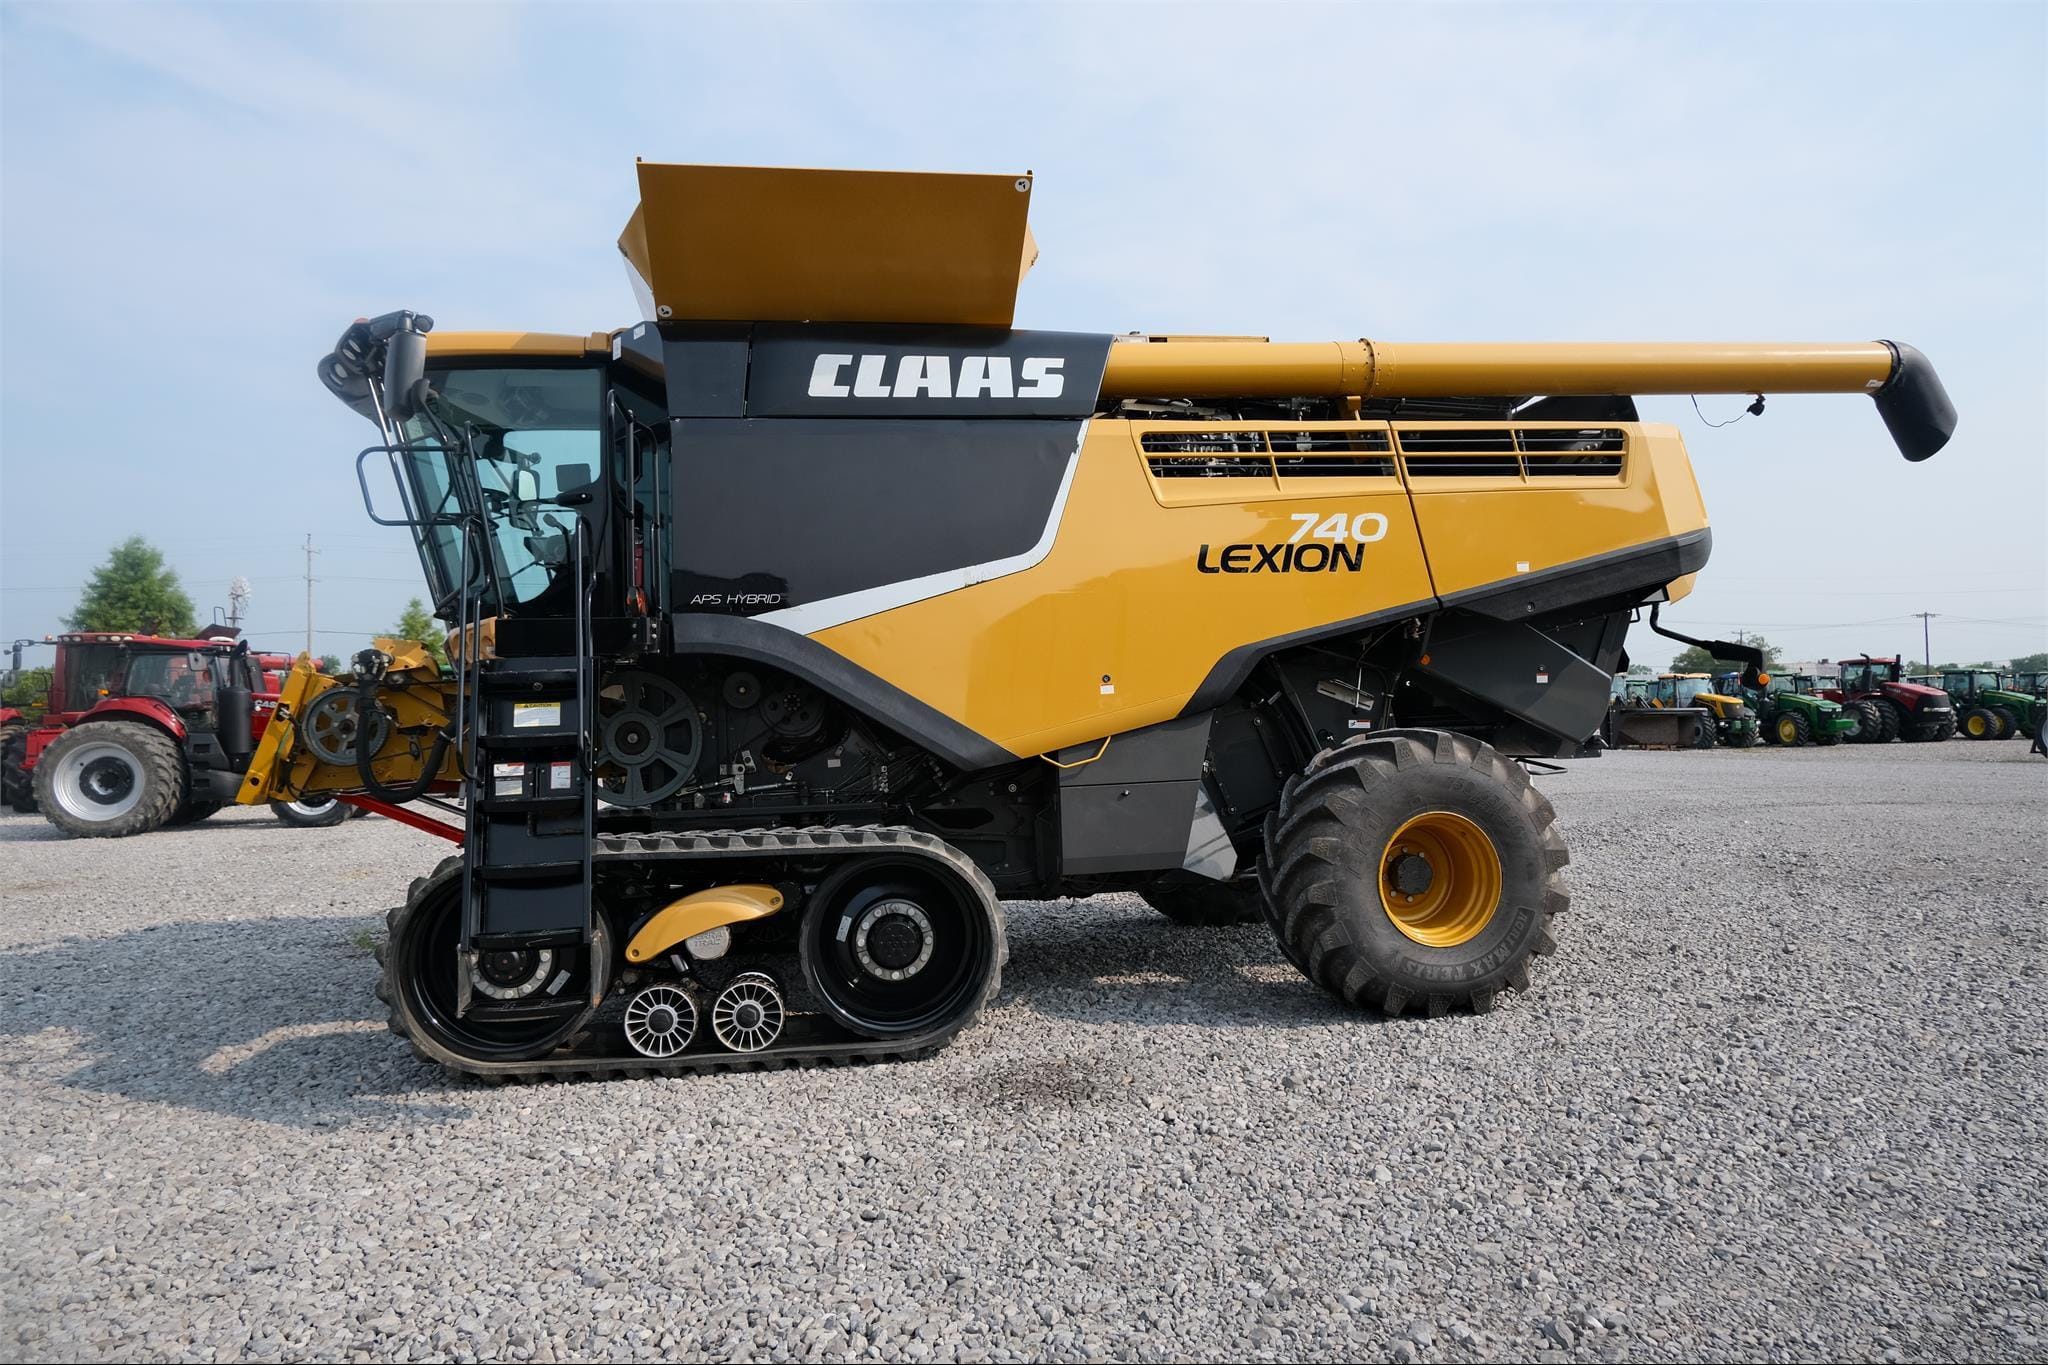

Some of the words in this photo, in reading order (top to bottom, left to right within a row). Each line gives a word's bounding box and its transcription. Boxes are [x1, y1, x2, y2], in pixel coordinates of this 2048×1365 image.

[808, 354, 1064, 398] CLAAS
[1288, 512, 1388, 543] 740
[1198, 543, 1366, 574] LEXION
[690, 594, 722, 605] APS
[727, 593, 781, 604] HYBRID
[255, 700, 277, 708] CAS
